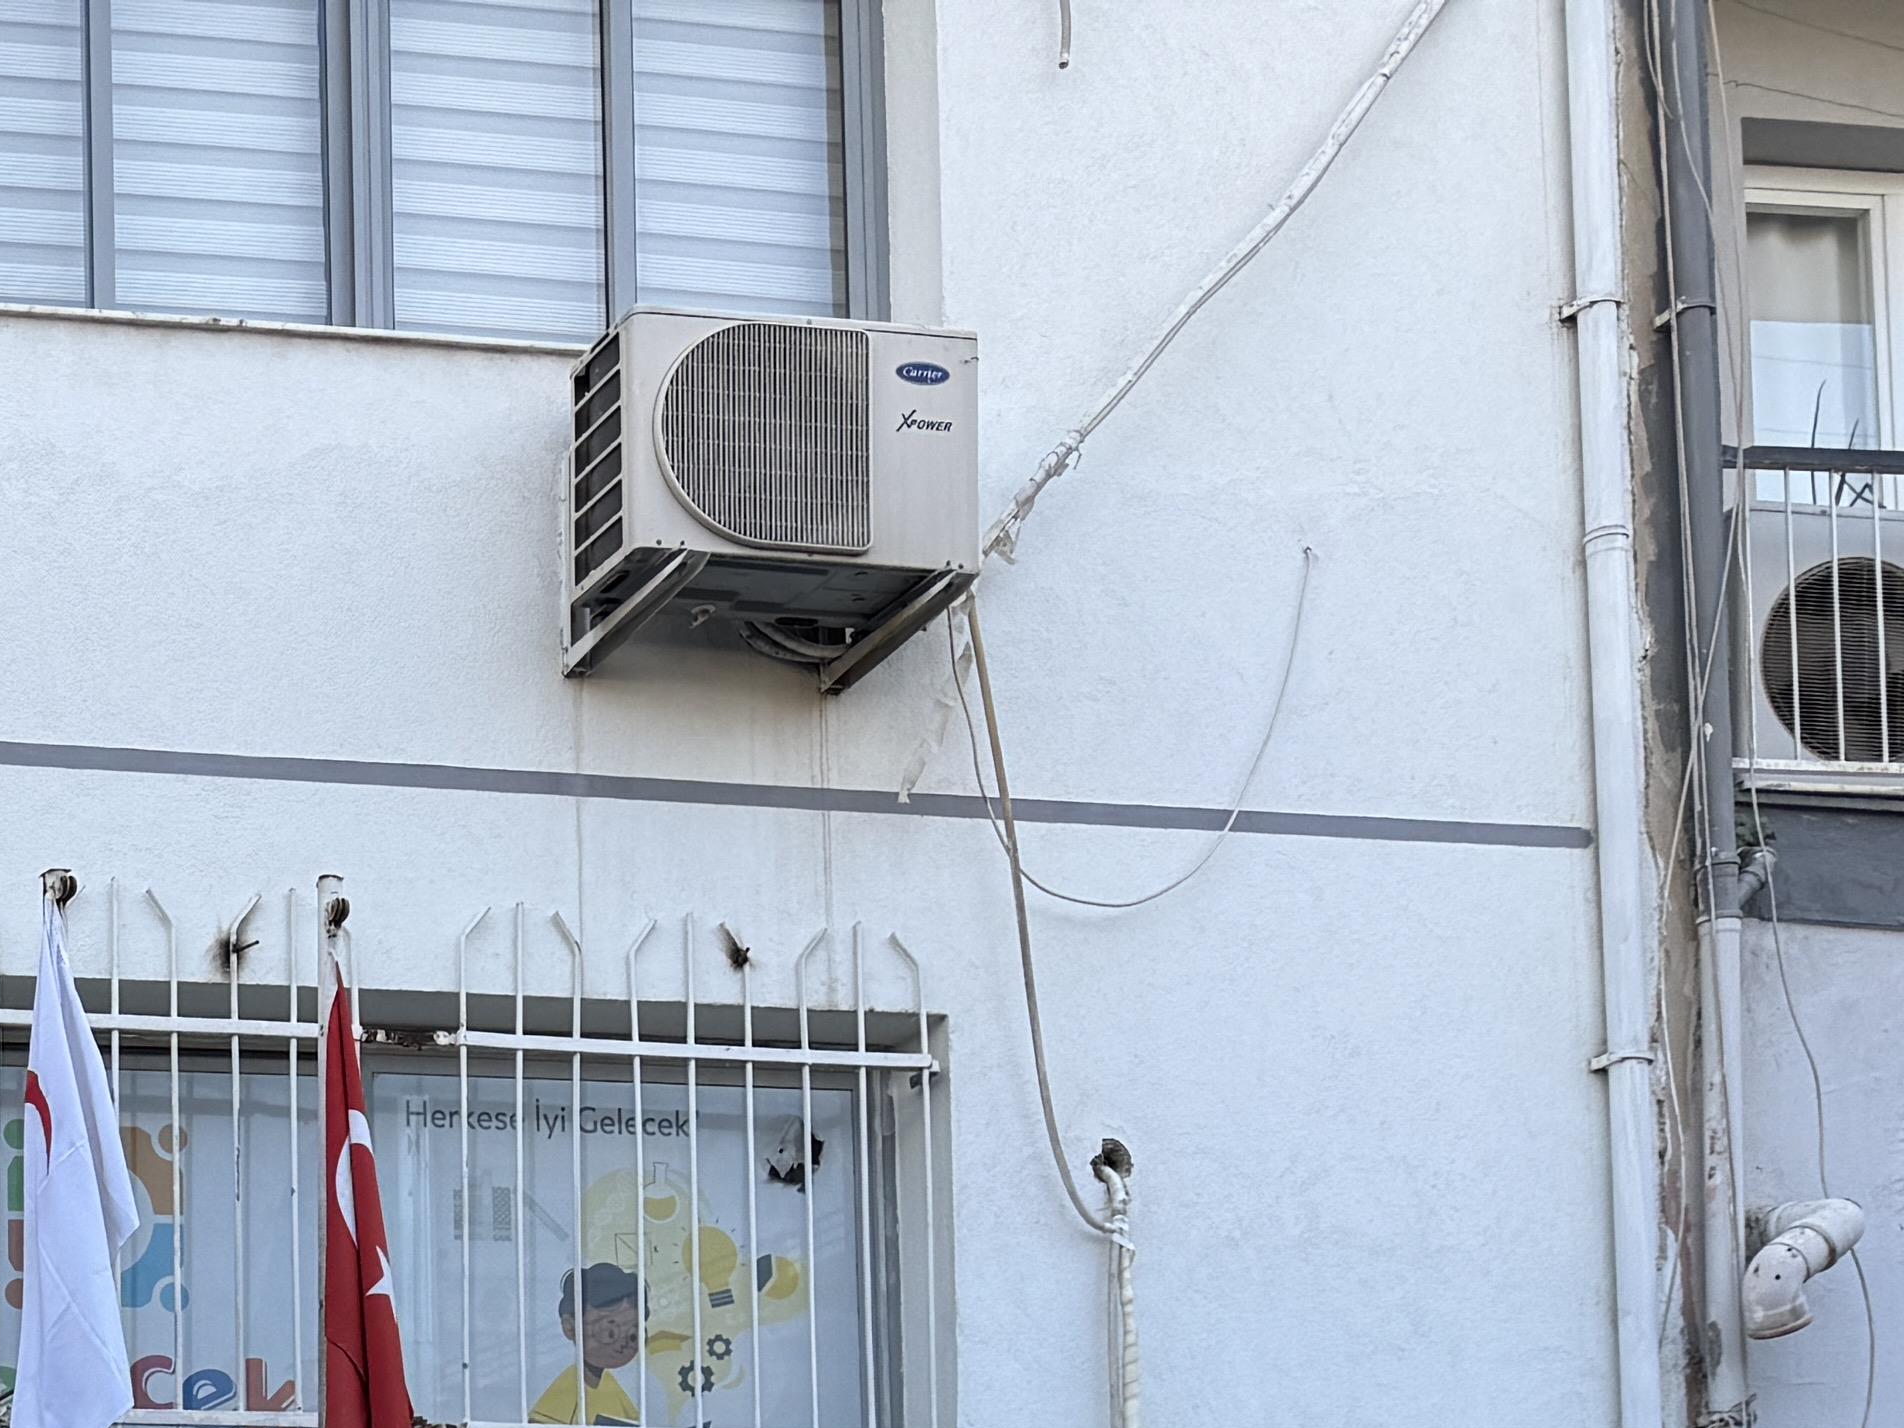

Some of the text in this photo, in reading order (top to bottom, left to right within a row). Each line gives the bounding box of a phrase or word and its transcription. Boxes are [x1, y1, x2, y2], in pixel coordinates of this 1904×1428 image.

[903, 366, 943, 384] Carrier
[405, 1099, 523, 1130] Herkese
[535, 1099, 566, 1139] İyi
